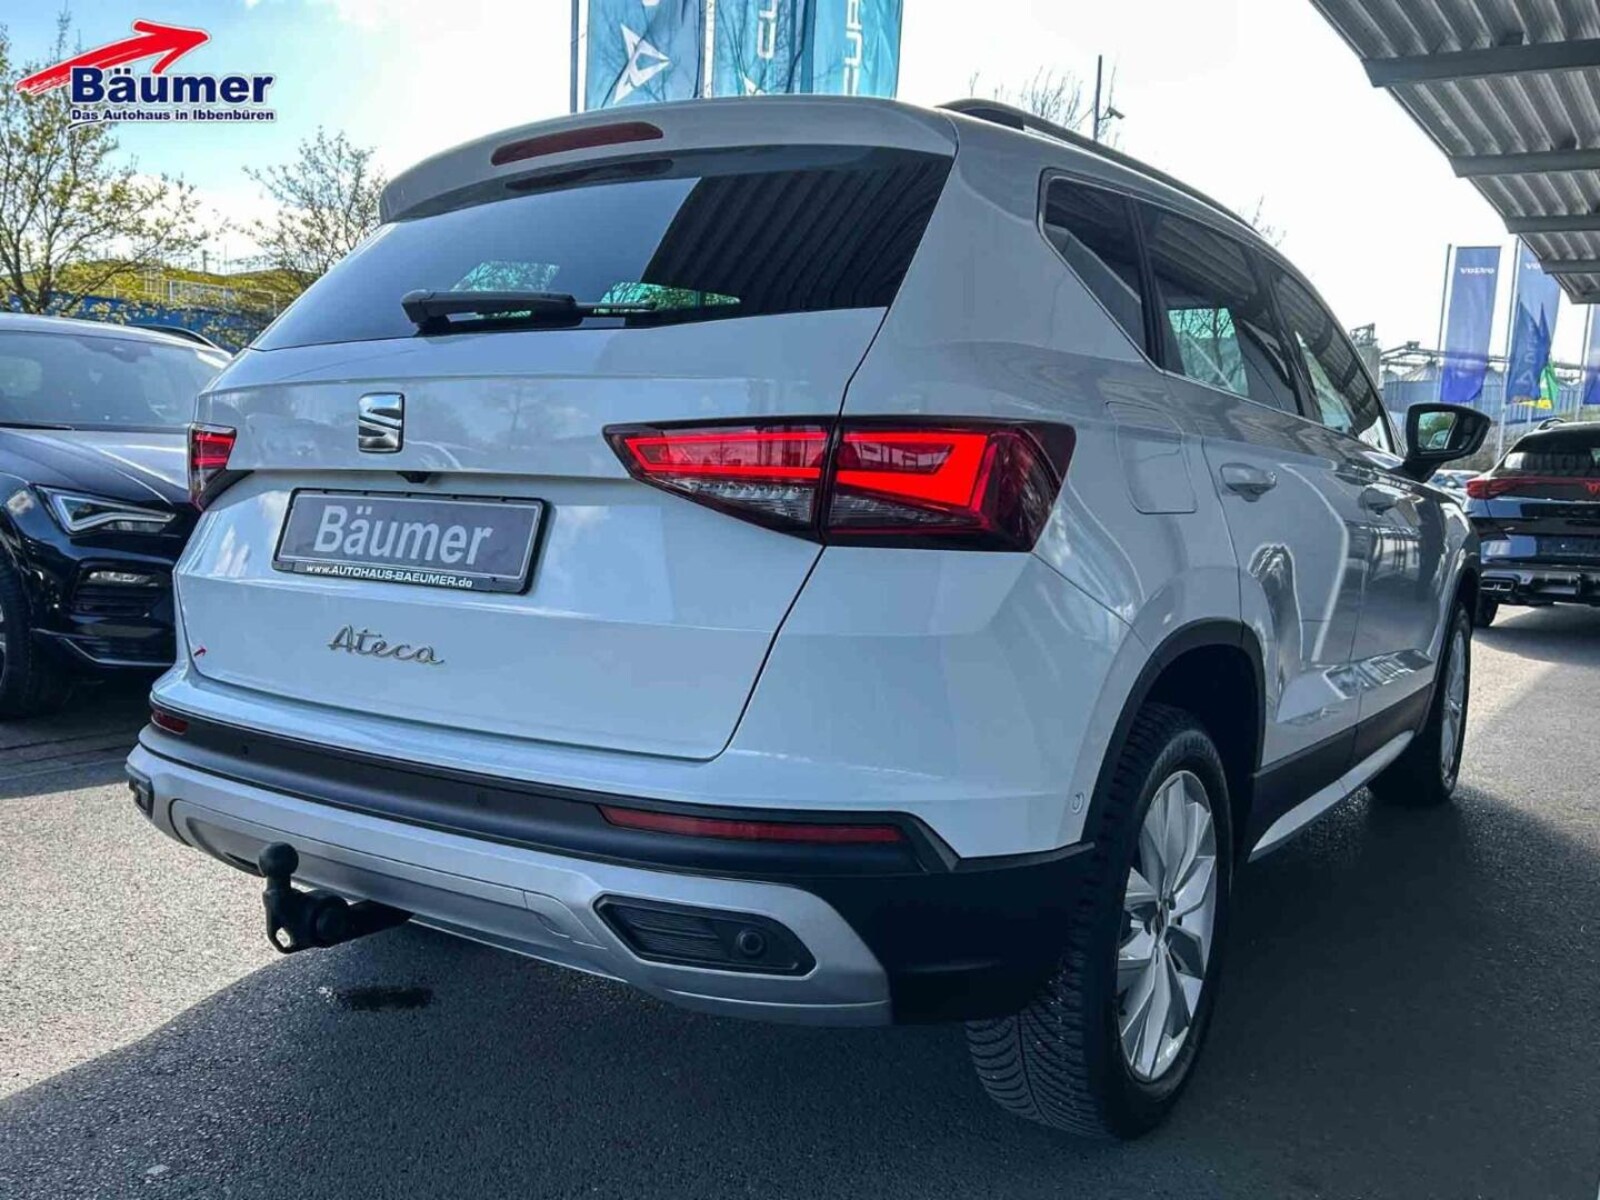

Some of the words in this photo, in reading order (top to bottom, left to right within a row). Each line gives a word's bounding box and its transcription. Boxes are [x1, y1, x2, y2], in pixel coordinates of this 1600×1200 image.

[1460, 266, 1495, 275] VOLVO
[313, 504, 494, 566] Bäumer
[327, 624, 445, 665] Ateca
